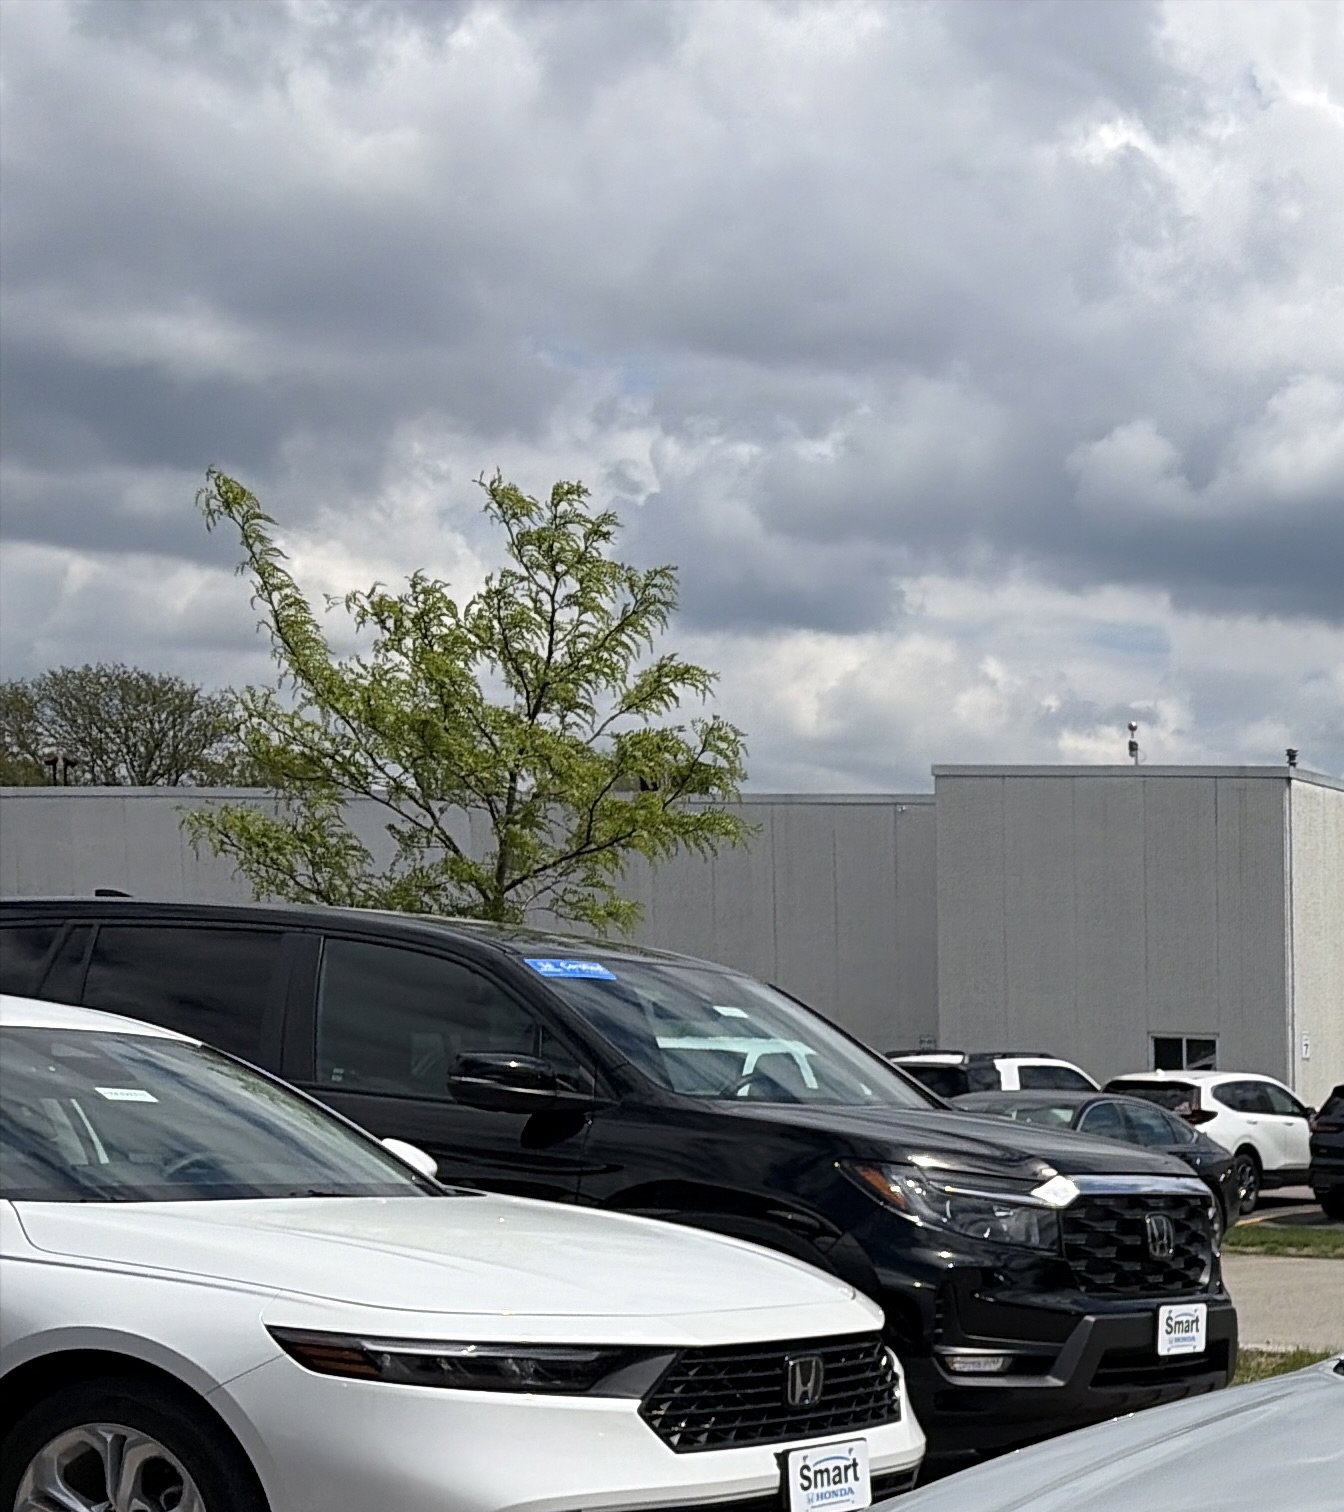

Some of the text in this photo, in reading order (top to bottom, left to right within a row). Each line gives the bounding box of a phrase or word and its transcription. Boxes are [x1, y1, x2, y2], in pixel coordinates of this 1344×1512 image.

[1165, 1315, 1200, 1335] Smart
[799, 1457, 860, 1491] Smart
[815, 1487, 856, 1502] HONDA
